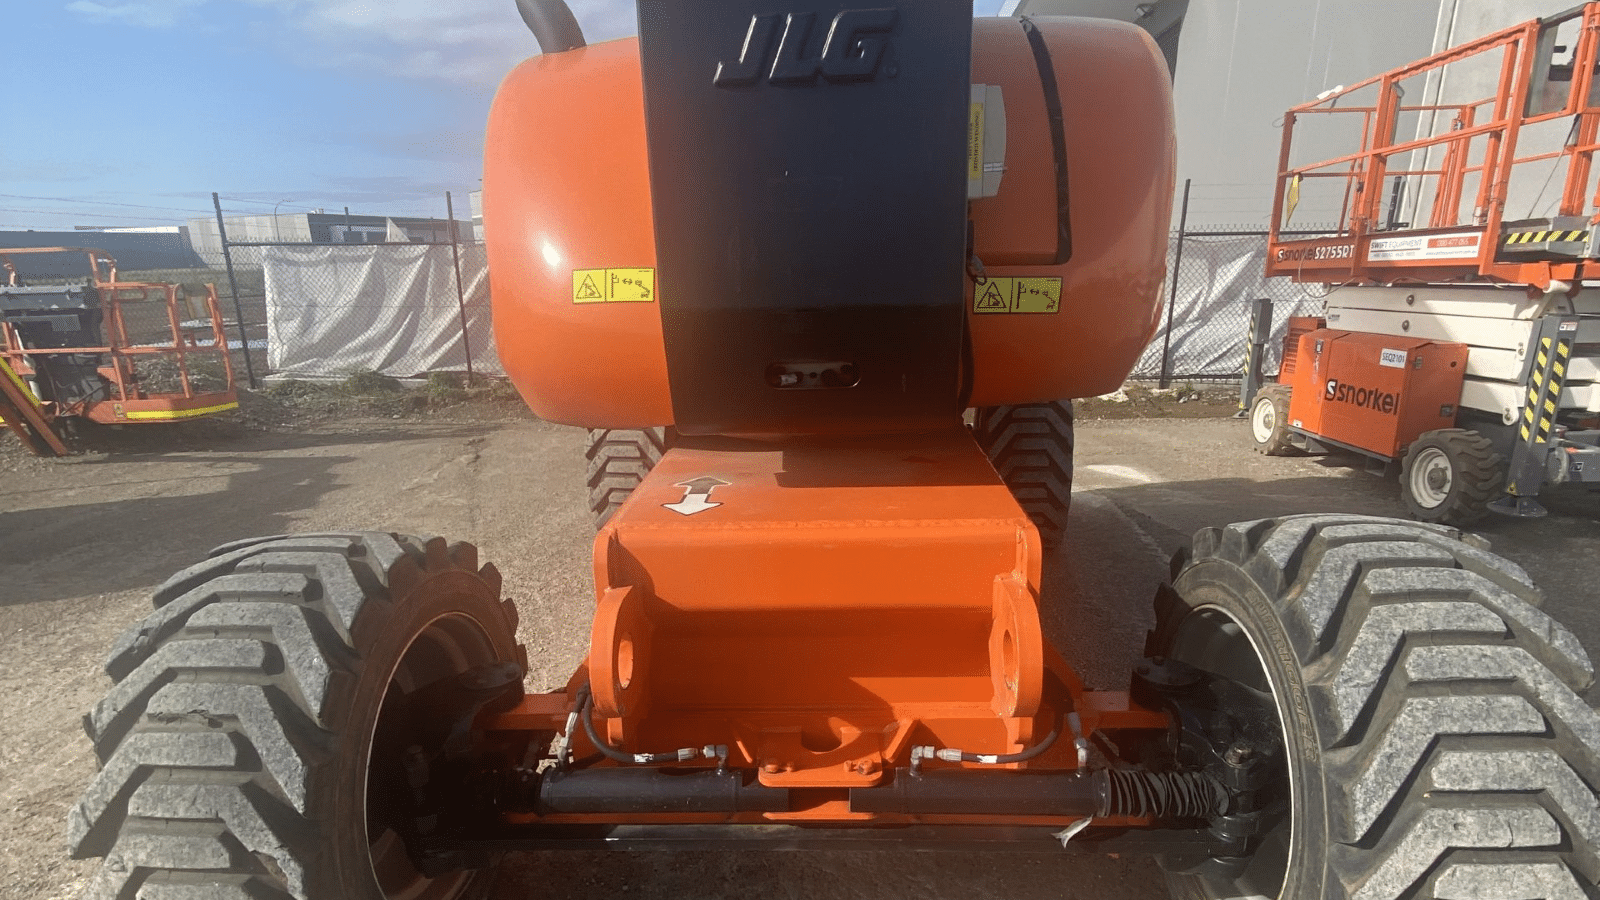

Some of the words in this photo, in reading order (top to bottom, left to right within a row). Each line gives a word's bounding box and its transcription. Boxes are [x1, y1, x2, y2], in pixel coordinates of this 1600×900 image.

[713, 8, 898, 89] JLG
[1314, 244, 1355, 260] S2755RT
[1370, 241, 1388, 249] SWIFT
